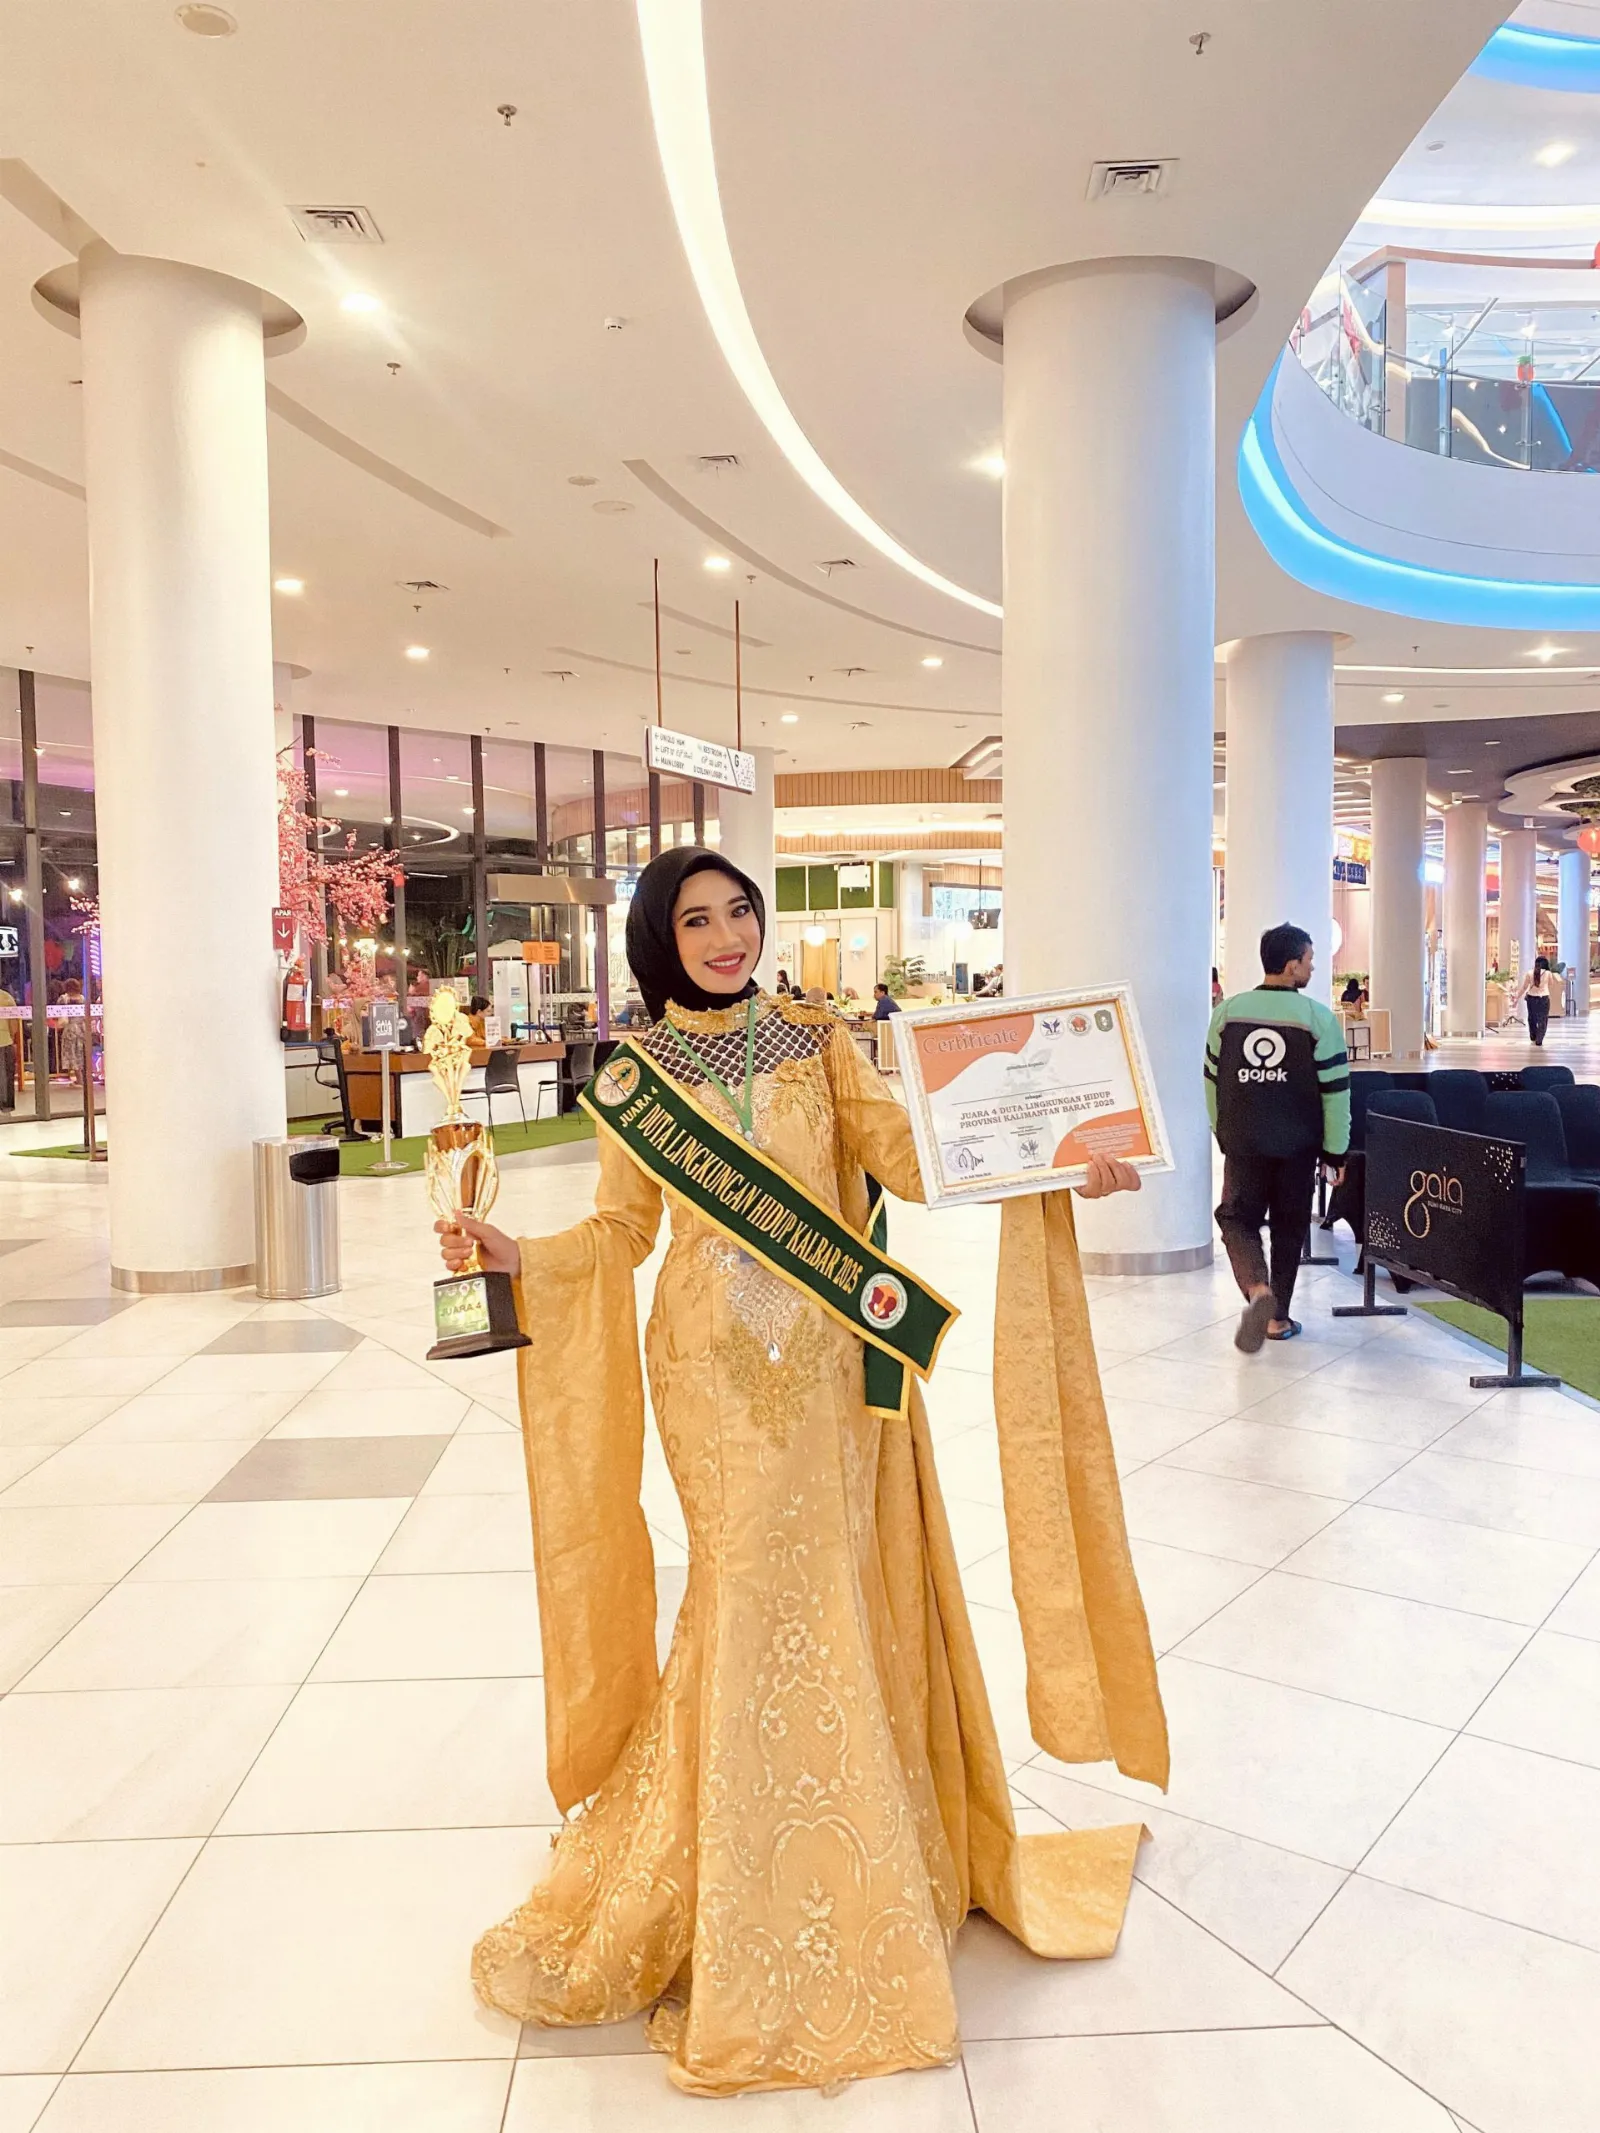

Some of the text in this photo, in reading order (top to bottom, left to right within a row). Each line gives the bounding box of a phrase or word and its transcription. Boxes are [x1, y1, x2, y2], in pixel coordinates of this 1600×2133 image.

[734, 754, 740, 768] G
[274, 909, 292, 917] APAR
[922, 1028, 1020, 1055] Certificate
[1237, 1068, 1288, 1083] gojek
[619, 1085, 659, 1128] JUARA 4
[959, 1116, 1002, 1129] PROVINSI
[1003, 1107, 1061, 1123] KALIMANTAN
[1063, 1101, 1092, 1113] BARAT
[960, 1109, 990, 1121] JUARA
[1000, 1104, 1023, 1114] DUTA
[1025, 1096, 1081, 1110] LINGKUNGAN
[1083, 1090, 1112, 1101] HIDUP
[636, 1103, 863, 1294] DUTA LINGKUNGAN HIDUP KALBAR 2025
[1403, 1166, 1463, 1238] gaia
[440, 1303, 474, 1317] JUARA
